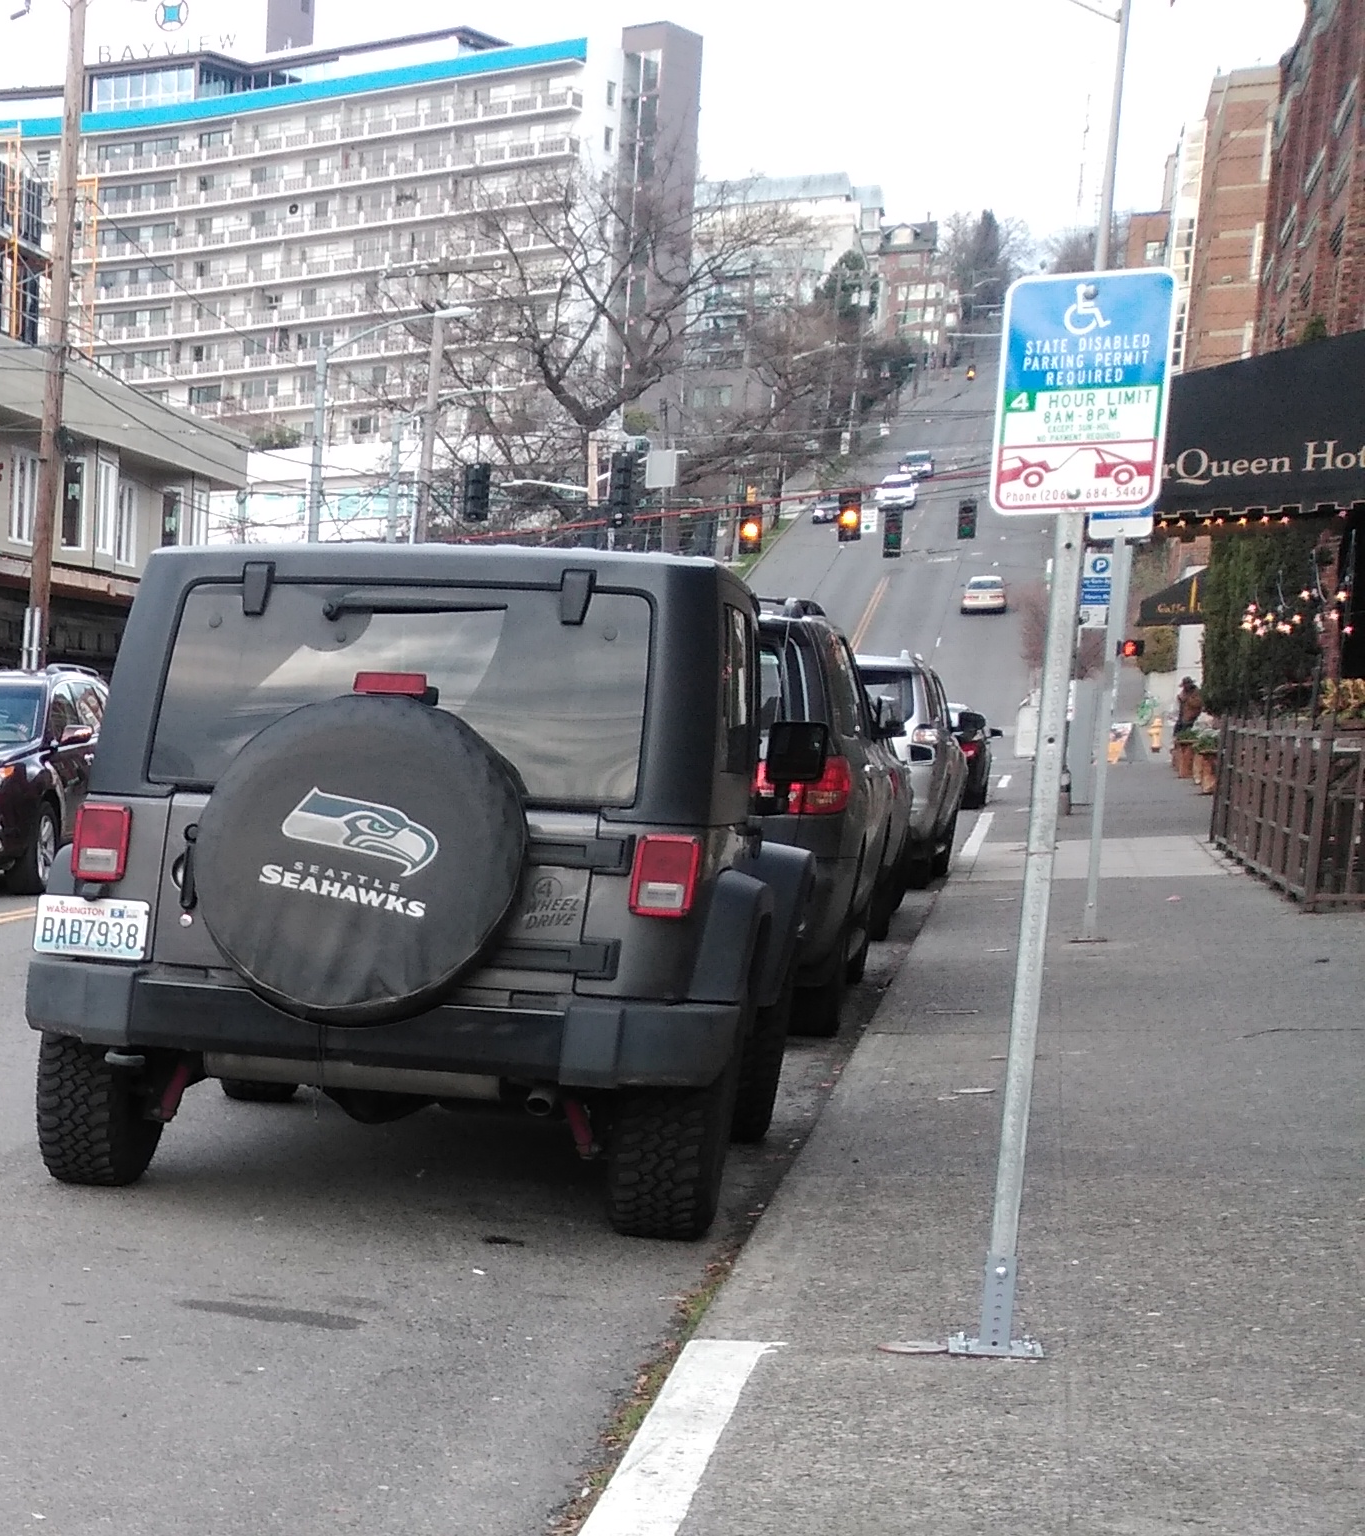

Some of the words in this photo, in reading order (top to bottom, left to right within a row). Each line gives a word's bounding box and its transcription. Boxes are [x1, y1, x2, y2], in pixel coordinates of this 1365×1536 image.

[98, 33, 237, 64] BAYVIEW
[1025, 338, 1068, 356] STATE
[1078, 333, 1151, 352] DISABLED
[1022, 354, 1084, 371] PARKING
[1094, 349, 1149, 367] PERMIT
[1045, 368, 1124, 386] REQUIRED
[1010, 391, 1029, 410] 4
[1049, 393, 1096, 409] HOUR
[1107, 389, 1153, 406] LIMIT
[1043, 408, 1118, 424] 8AM-8PM
[1047, 424, 1074, 433] EXCEPT
[1050, 433, 1082, 442] PAYMENT
[1086, 431, 1121, 441] REQUIRED
[1162, 448, 1291, 485] rQueen
[1301, 440, 1365, 472] Hot
[1006, 491, 1037, 501] Phone
[1086, 486, 1144, 498] 684-5444
[293, 861, 401, 892] SEATTLE
[258, 864, 427, 917] SEAHAWKS
[537, 880, 553, 898] 4
[46, 905, 106, 917] WASHINGTON
[526, 899, 579, 914] WHEEL
[525, 913, 577, 930] DRIVE
[41, 916, 140, 950] BAB7938
